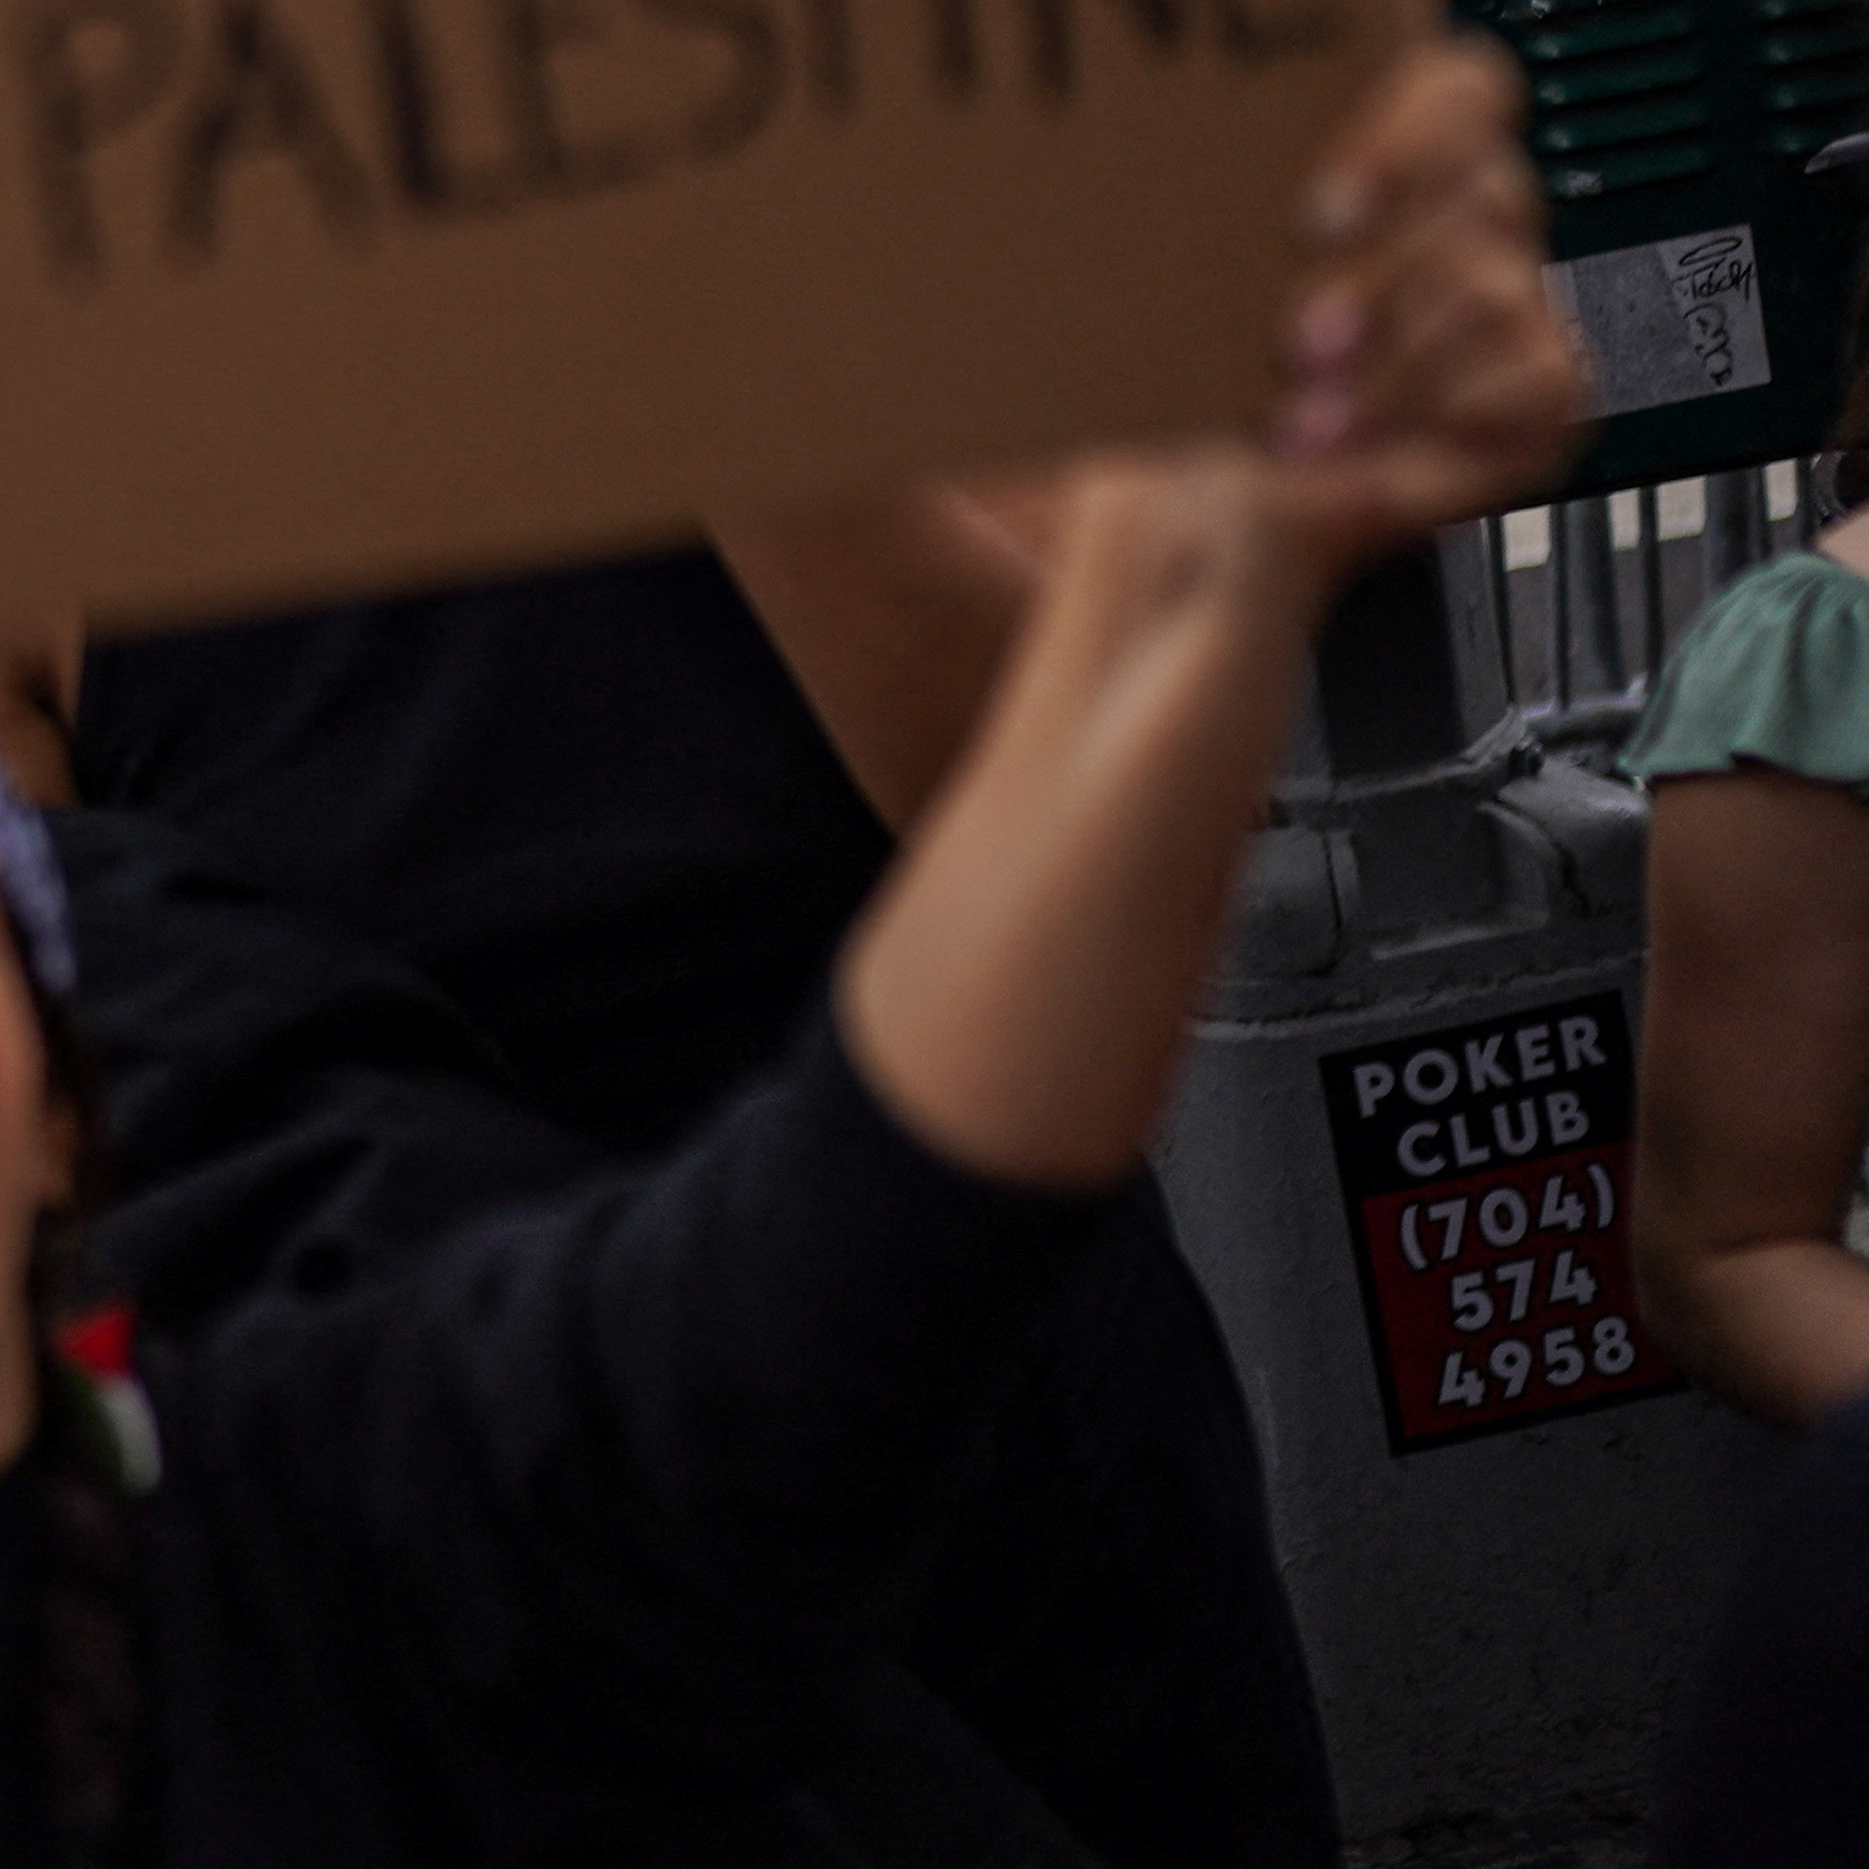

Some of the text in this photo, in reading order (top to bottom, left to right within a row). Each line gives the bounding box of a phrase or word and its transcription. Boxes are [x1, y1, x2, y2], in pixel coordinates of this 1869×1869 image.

[1352, 1015, 1607, 1118] POKER
[1396, 1089, 1591, 1179] CLUB
[1399, 1162, 1615, 1271] (704)
[1450, 1247, 1598, 1332] 574
[1437, 1315, 1637, 1409] 4958
